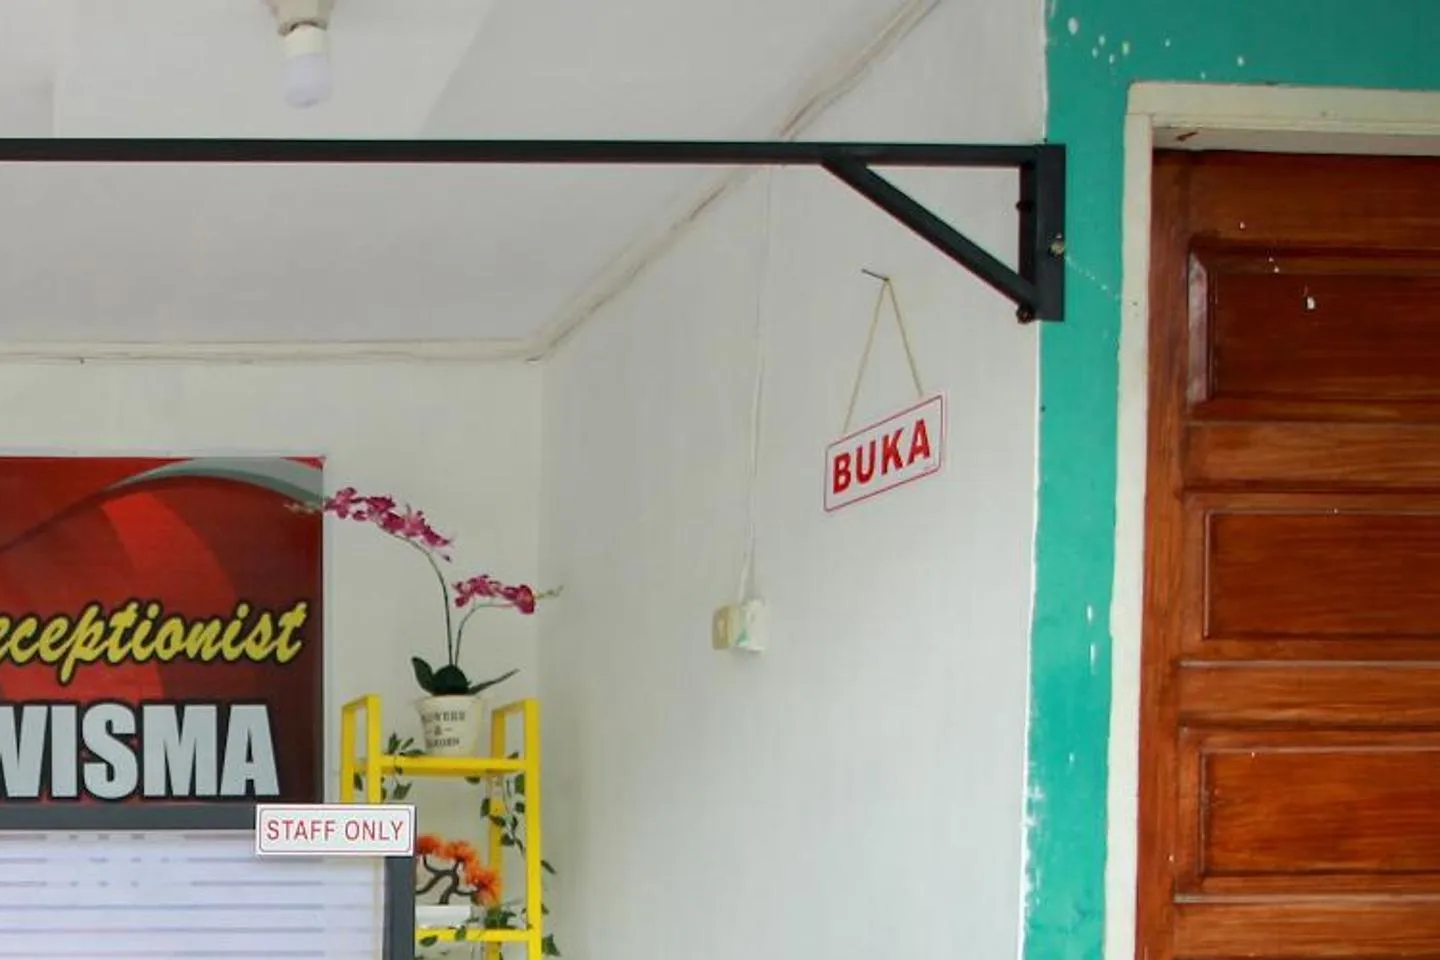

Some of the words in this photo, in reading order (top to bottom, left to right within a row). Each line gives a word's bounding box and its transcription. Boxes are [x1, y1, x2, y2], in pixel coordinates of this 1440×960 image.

[832, 418, 931, 495] BUKA
[266, 819, 336, 842] STAFF
[344, 819, 404, 842] ONLY
